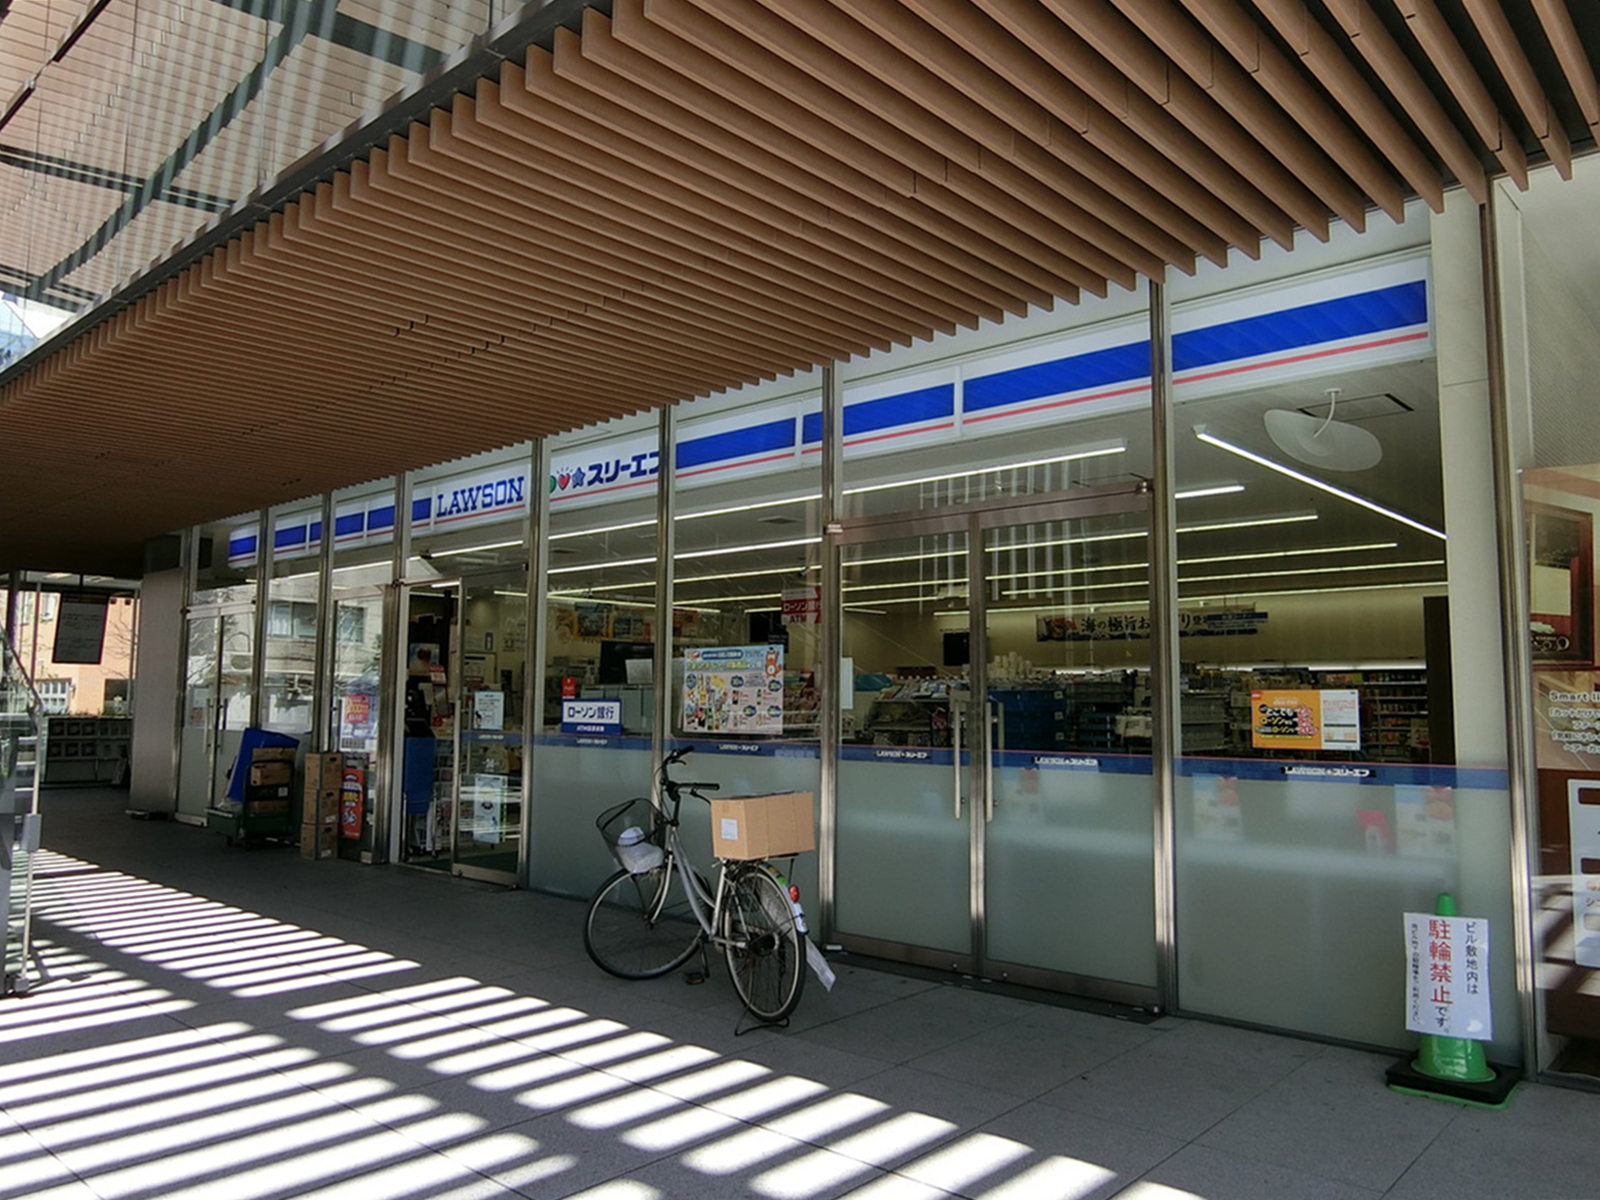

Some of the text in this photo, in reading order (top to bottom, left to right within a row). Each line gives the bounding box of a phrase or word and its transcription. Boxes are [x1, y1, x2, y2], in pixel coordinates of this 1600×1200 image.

[437, 475, 525, 518] LAWSON
[789, 614, 807, 623] ATM
[1549, 691, 1588, 701] Smart
[568, 706, 614, 719] ローソン銀行
[1465, 922, 1479, 995] ビル敷地内は
[1428, 919, 1454, 1034] 駐輪禁止です。
